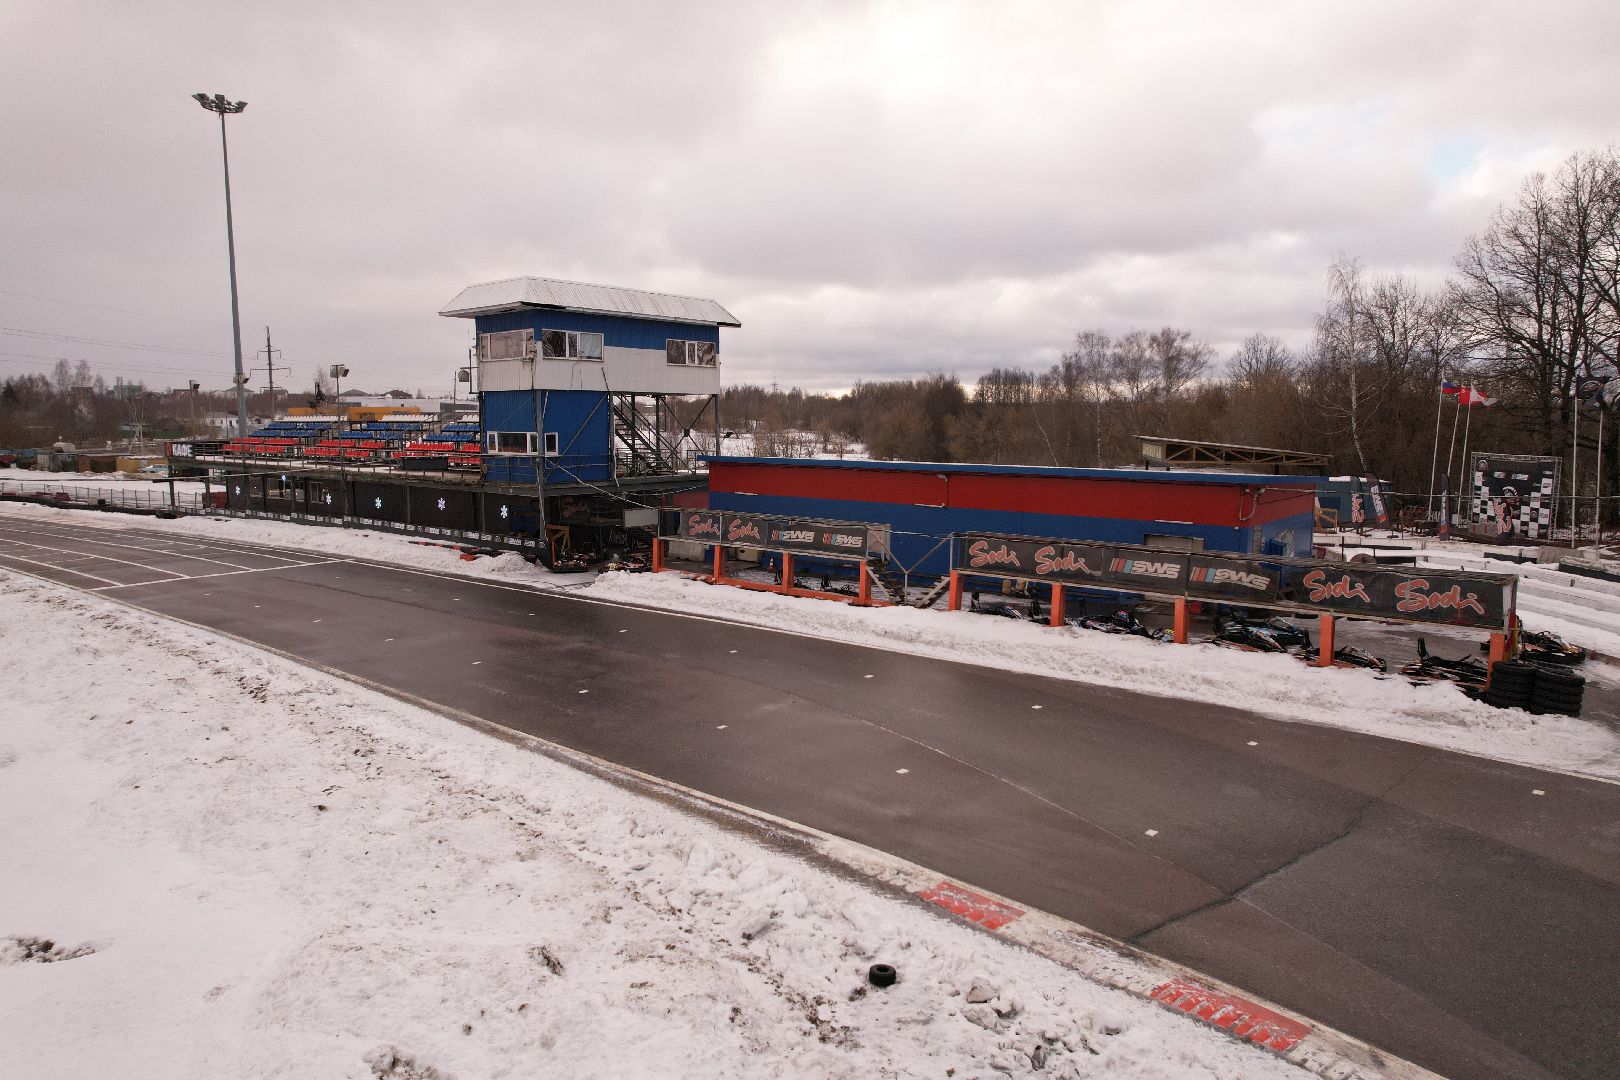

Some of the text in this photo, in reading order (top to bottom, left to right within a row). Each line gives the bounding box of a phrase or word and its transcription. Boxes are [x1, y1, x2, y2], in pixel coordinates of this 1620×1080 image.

[172, 443, 193, 457] КАФЕ
[688, 514, 863, 548] Sodi Sodi SWS SWS
[969, 540, 1271, 591] Sodi Sodi SWS SWS
[1394, 578, 1485, 615] Sodi
